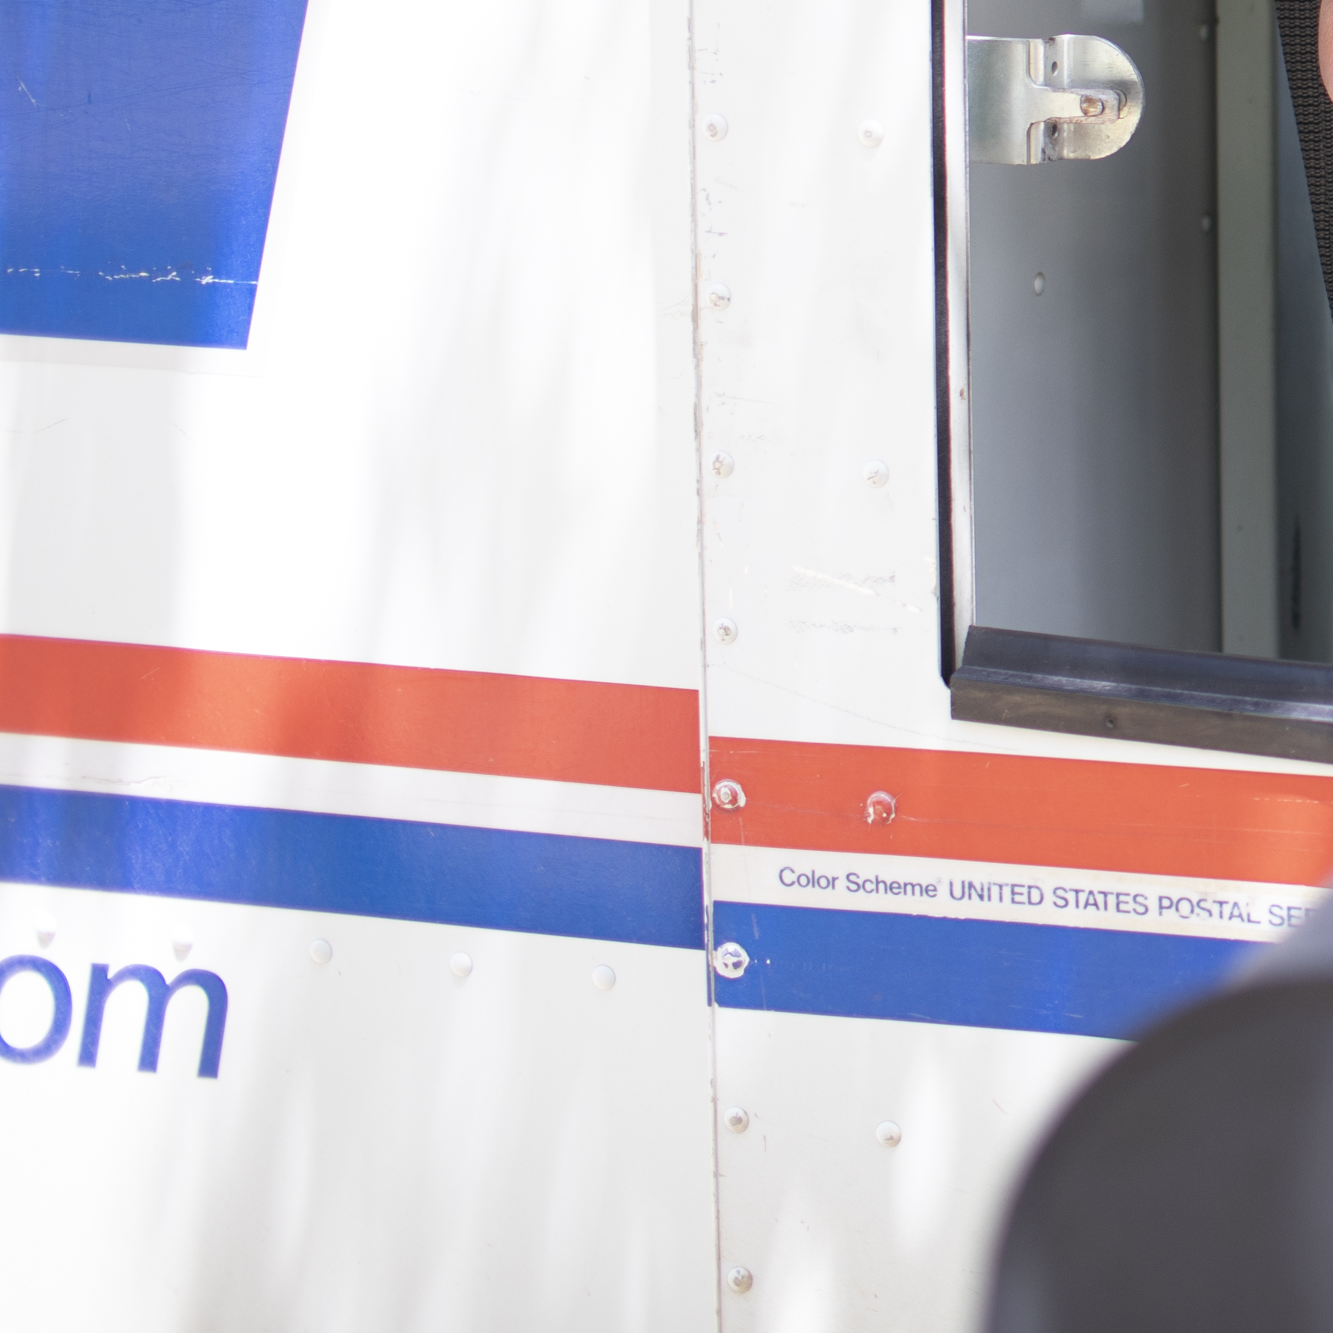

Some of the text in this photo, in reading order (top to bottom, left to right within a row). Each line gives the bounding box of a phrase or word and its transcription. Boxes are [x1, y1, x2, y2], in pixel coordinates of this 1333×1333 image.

[778, 866, 839, 890] Color
[949, 879, 1045, 906] UNITED
[1052, 886, 1150, 916] STATES
[1158, 895, 1262, 925] POSTAL
